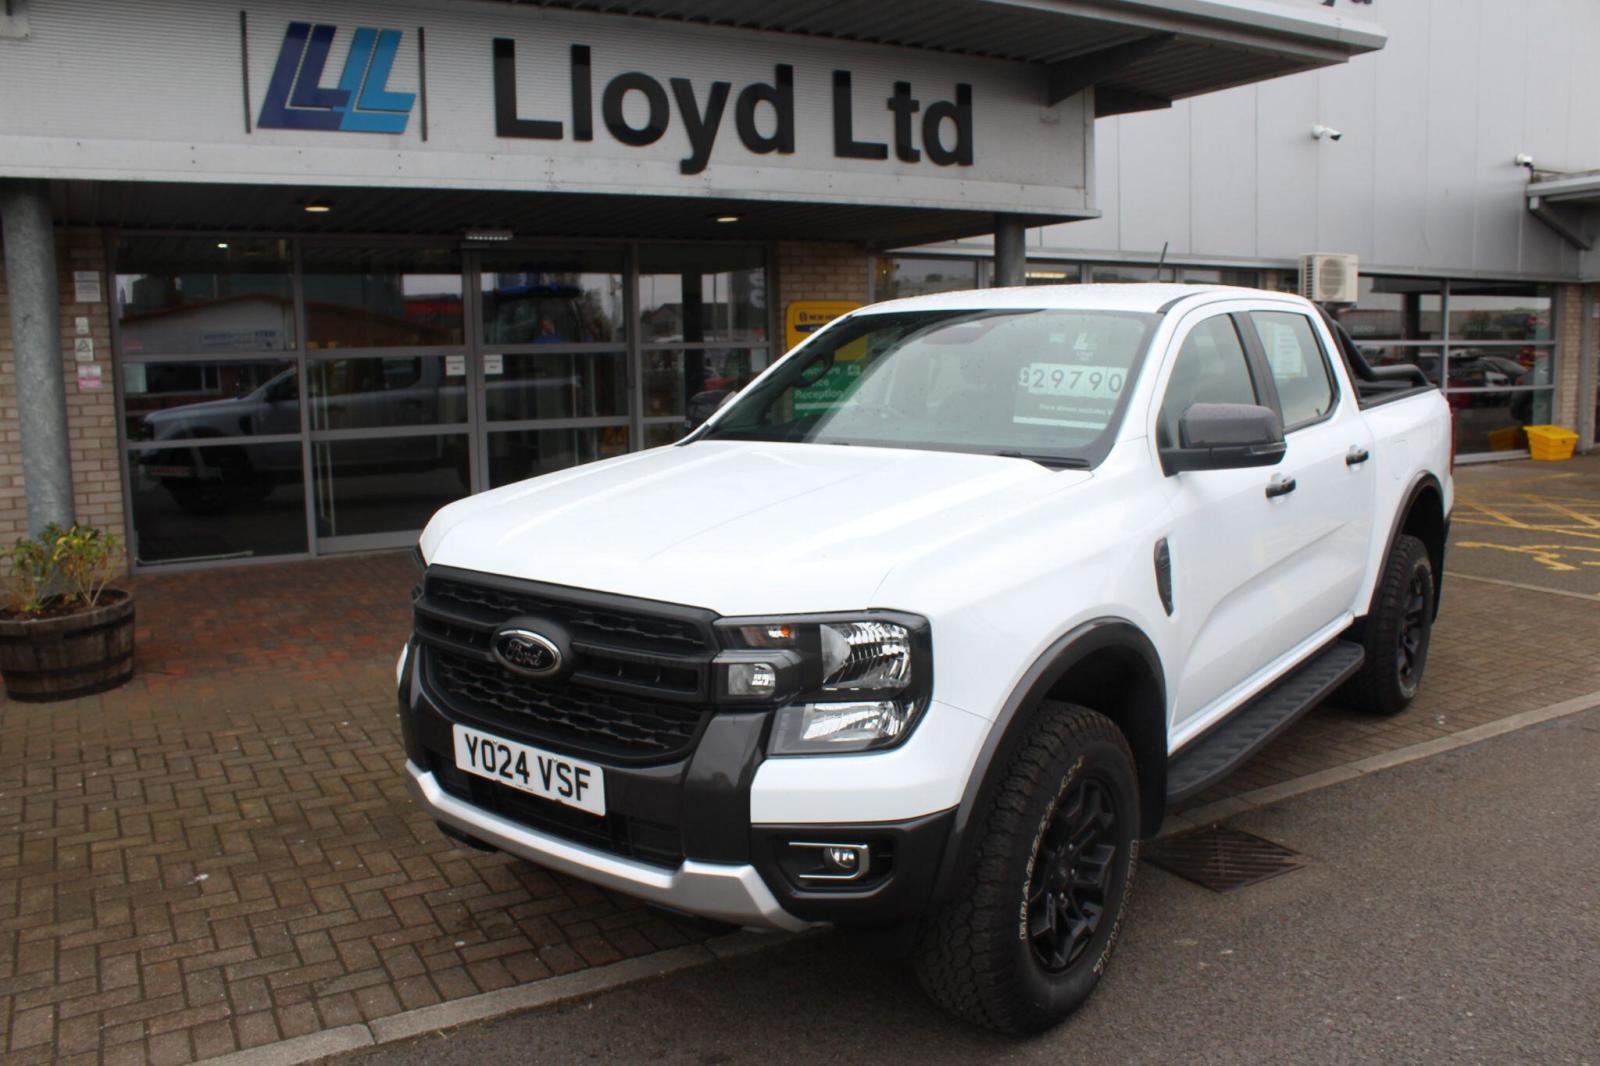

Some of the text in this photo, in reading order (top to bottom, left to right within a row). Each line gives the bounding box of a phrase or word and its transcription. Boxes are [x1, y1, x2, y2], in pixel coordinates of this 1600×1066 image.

[493, 37, 974, 175] Lloyd Ltd
[505, 638, 543, 667] Ford
[537, 755, 591, 801] VSF
